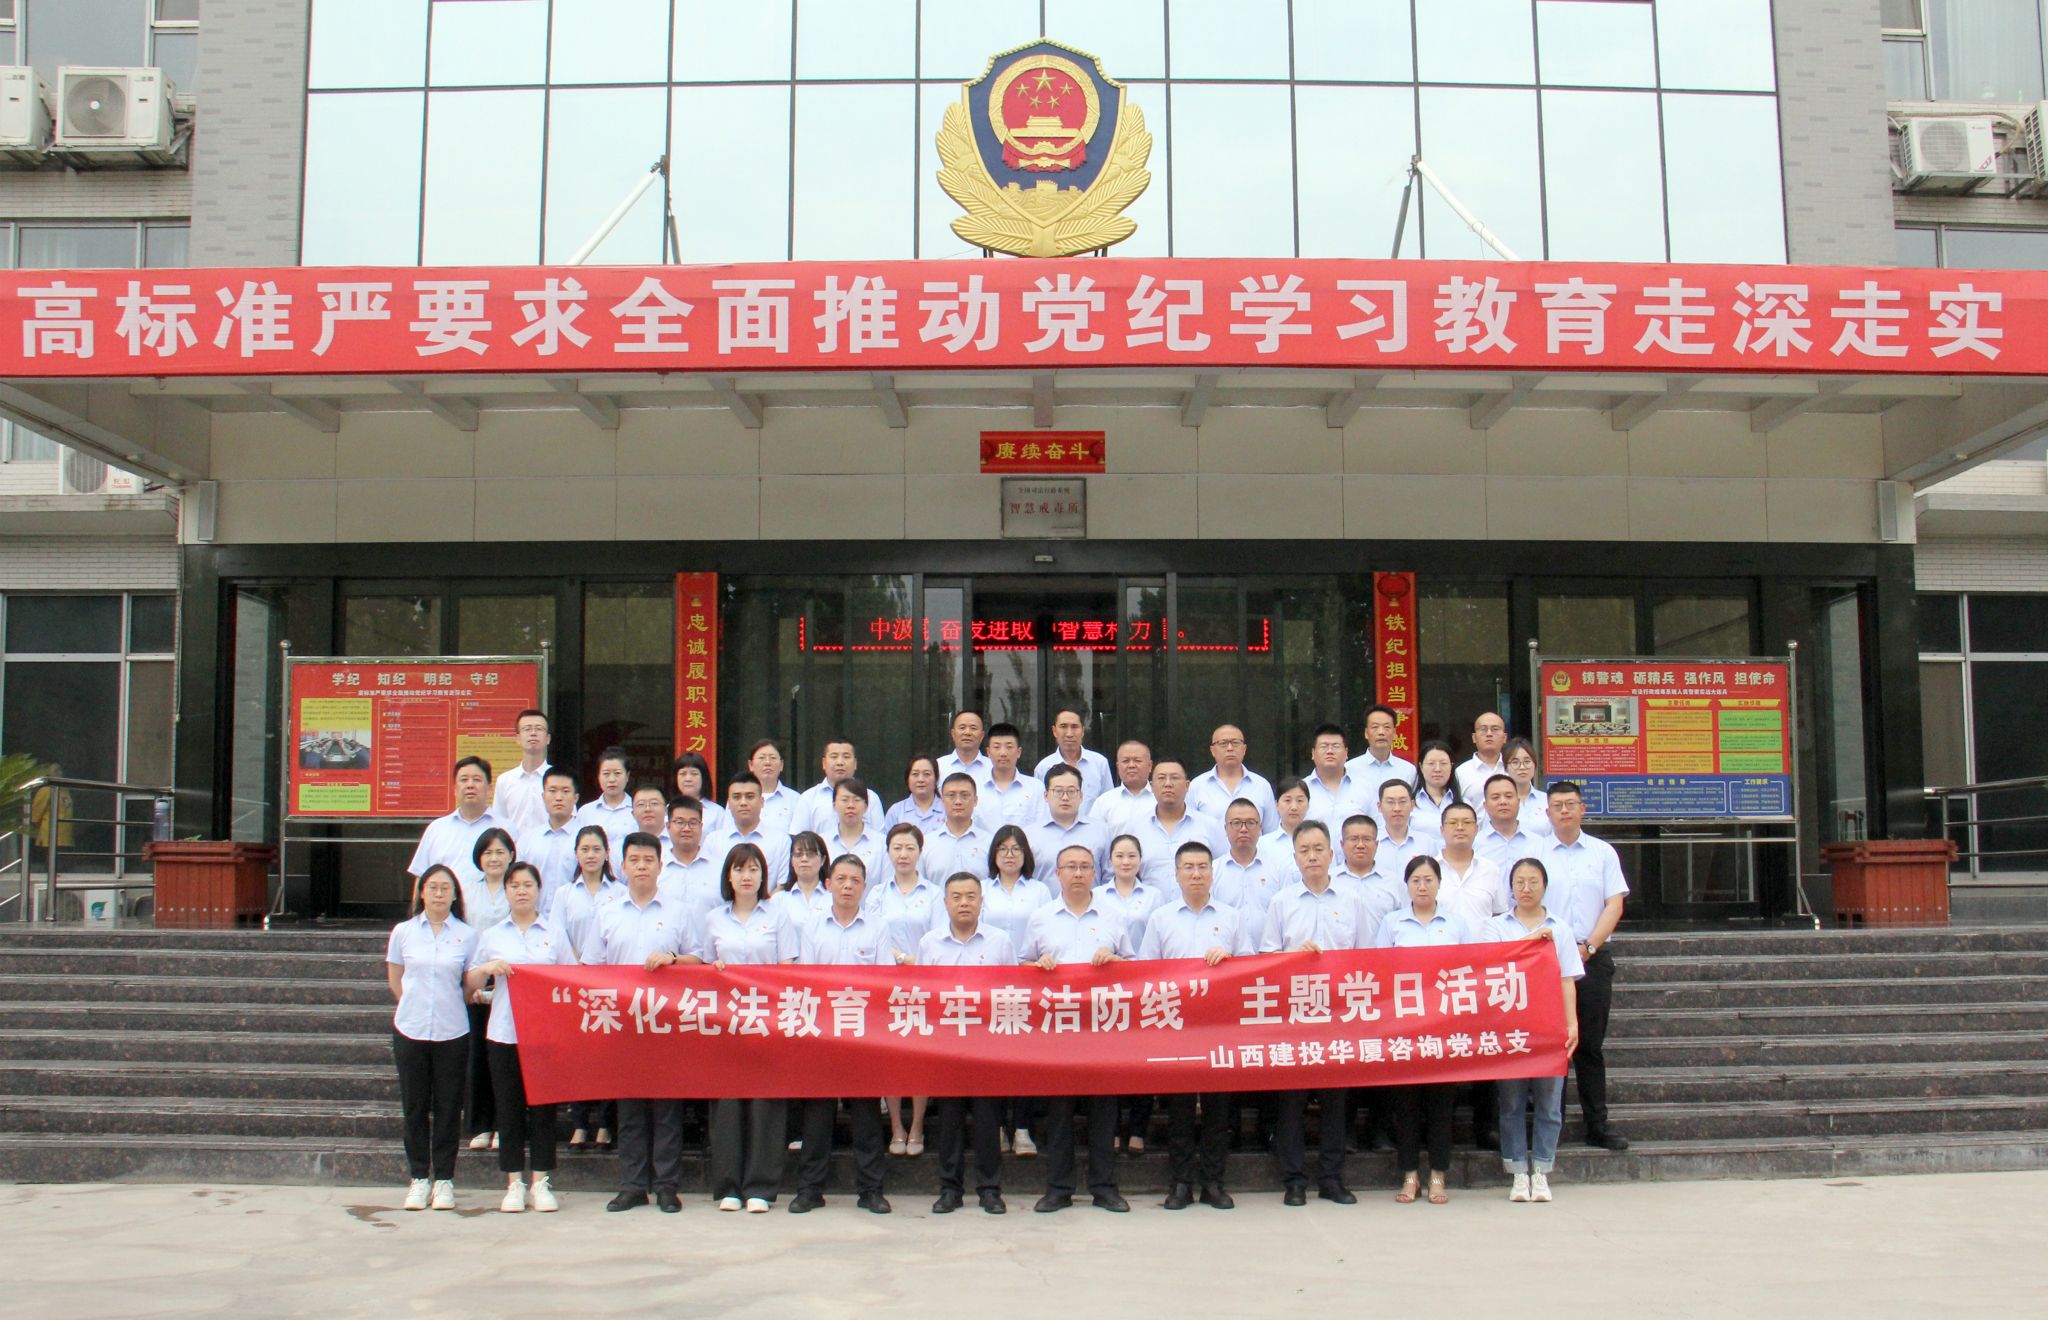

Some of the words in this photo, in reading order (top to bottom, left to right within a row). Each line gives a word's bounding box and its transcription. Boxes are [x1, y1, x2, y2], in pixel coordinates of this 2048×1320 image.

[16, 274, 2004, 361] 高标准严要求全面推动党纪学习教育走深走实
[995, 442, 1090, 460] 赓续奋斗
[332, 672, 360, 686] 学纪
[377, 672, 406, 686] 知纪
[424, 672, 452, 686] 明纪
[470, 672, 499, 686] 守纪
[685, 613, 709, 752] 忠诚履职聚力
[1582, 671, 1624, 685] 铸警魂
[1633, 671, 1675, 685] 砺精兵
[1684, 671, 1726, 685] 强作风
[1734, 671, 1776, 685] 担使命
[552, 986, 871, 1038] “深化纪法教育
[887, 980, 1209, 1038] 筑牢廉洁防线”
[1239, 961, 1528, 1026] 主题党日活动
